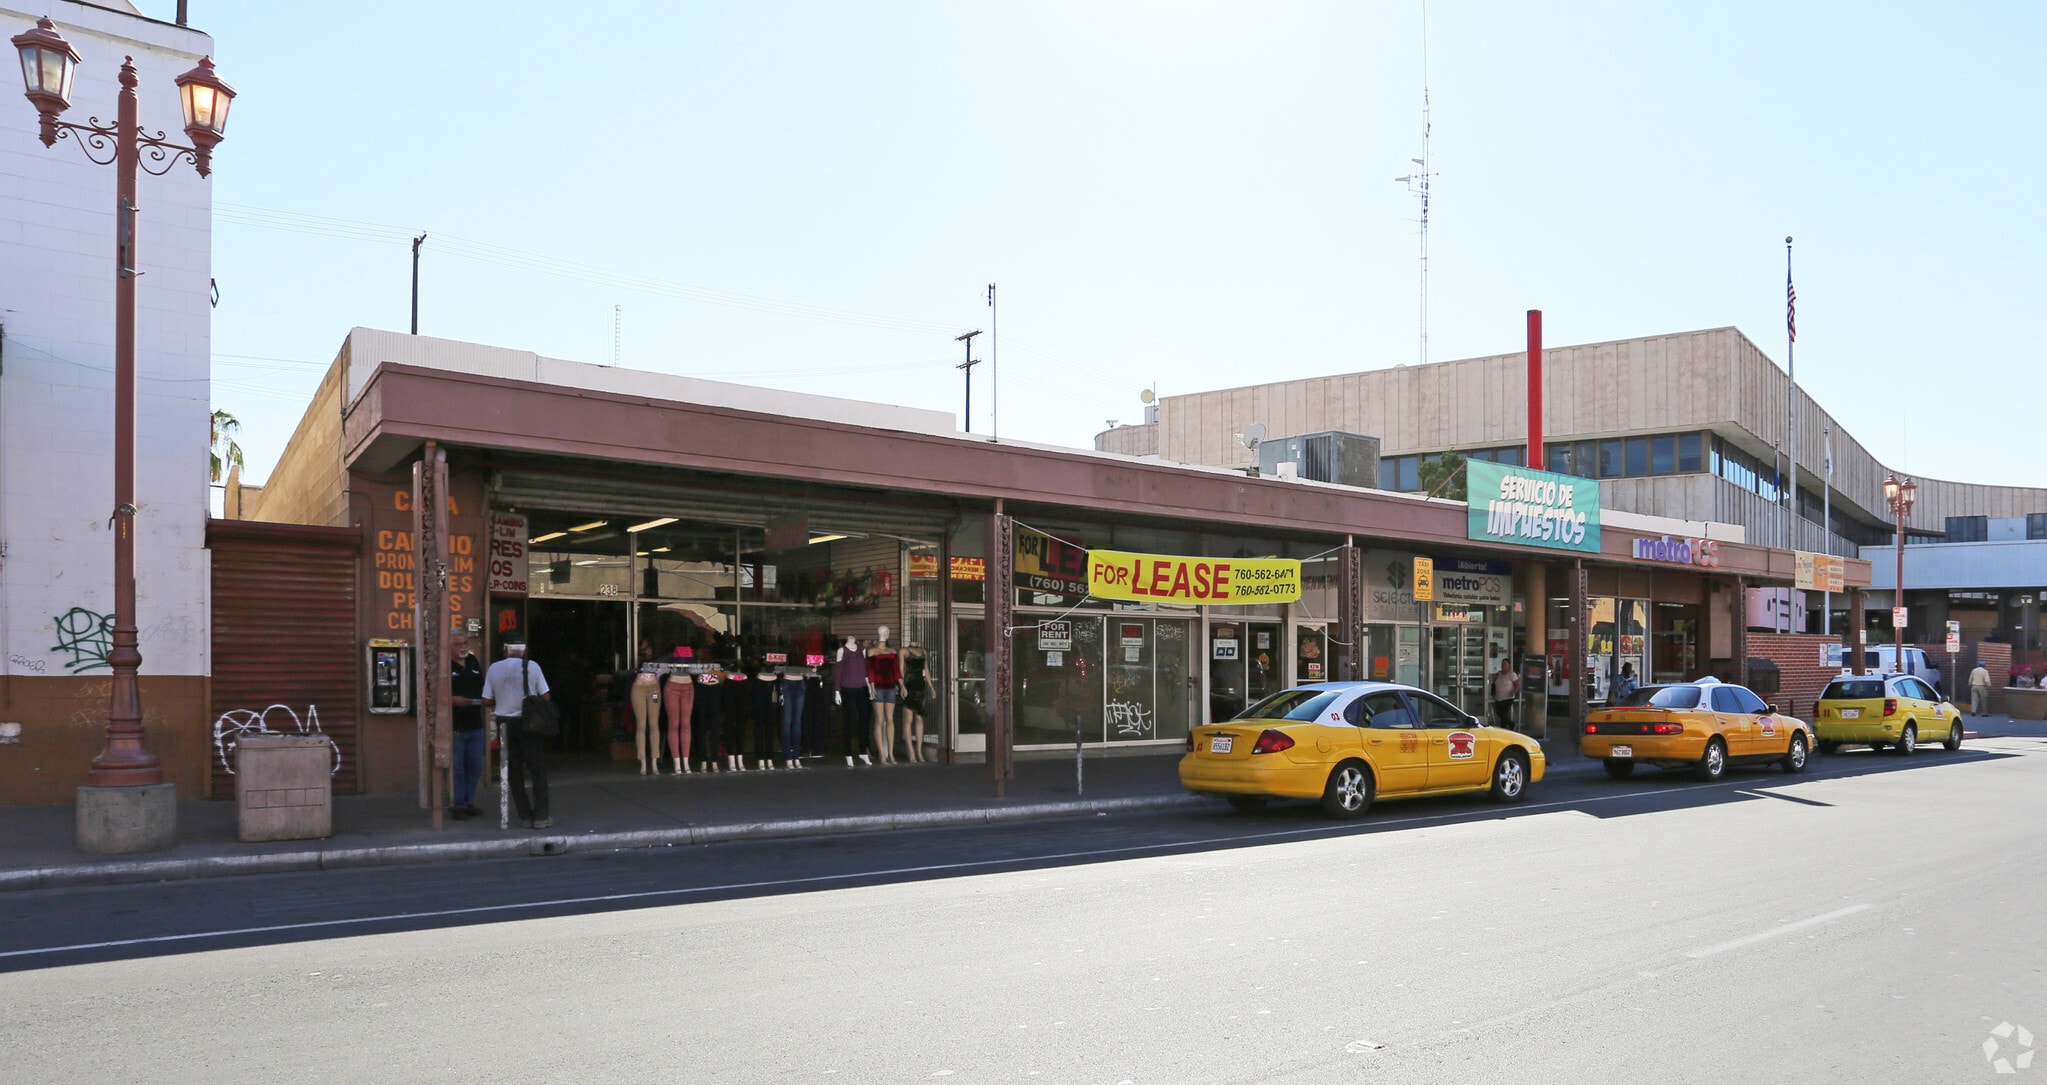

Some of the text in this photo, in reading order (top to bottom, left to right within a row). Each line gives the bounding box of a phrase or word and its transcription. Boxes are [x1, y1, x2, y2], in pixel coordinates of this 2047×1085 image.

[1500, 475, 1573, 509] SERVICIO DE
[394, 490, 459, 515] CA
[1486, 499, 1586, 545] IMPUESTOS
[378, 530, 472, 555] CAIO
[1018, 534, 1038, 556] FOR
[1634, 535, 1719, 567] metroPCS
[491, 560, 513, 577] OS
[379, 571, 473, 592] DOLES
[1029, 575, 1064, 592] (760)
[1093, 563, 1129, 587] FOR
[1131, 559, 1231, 599] LEASE
[1442, 576, 1501, 593] metroPCS
[600, 584, 618, 597] 238
[1234, 583, 1297, 596] 760-562-0773
[394, 592, 463, 612] PES
[1041, 631, 1069, 639] RENT
[1045, 623, 1066, 631] FOR
